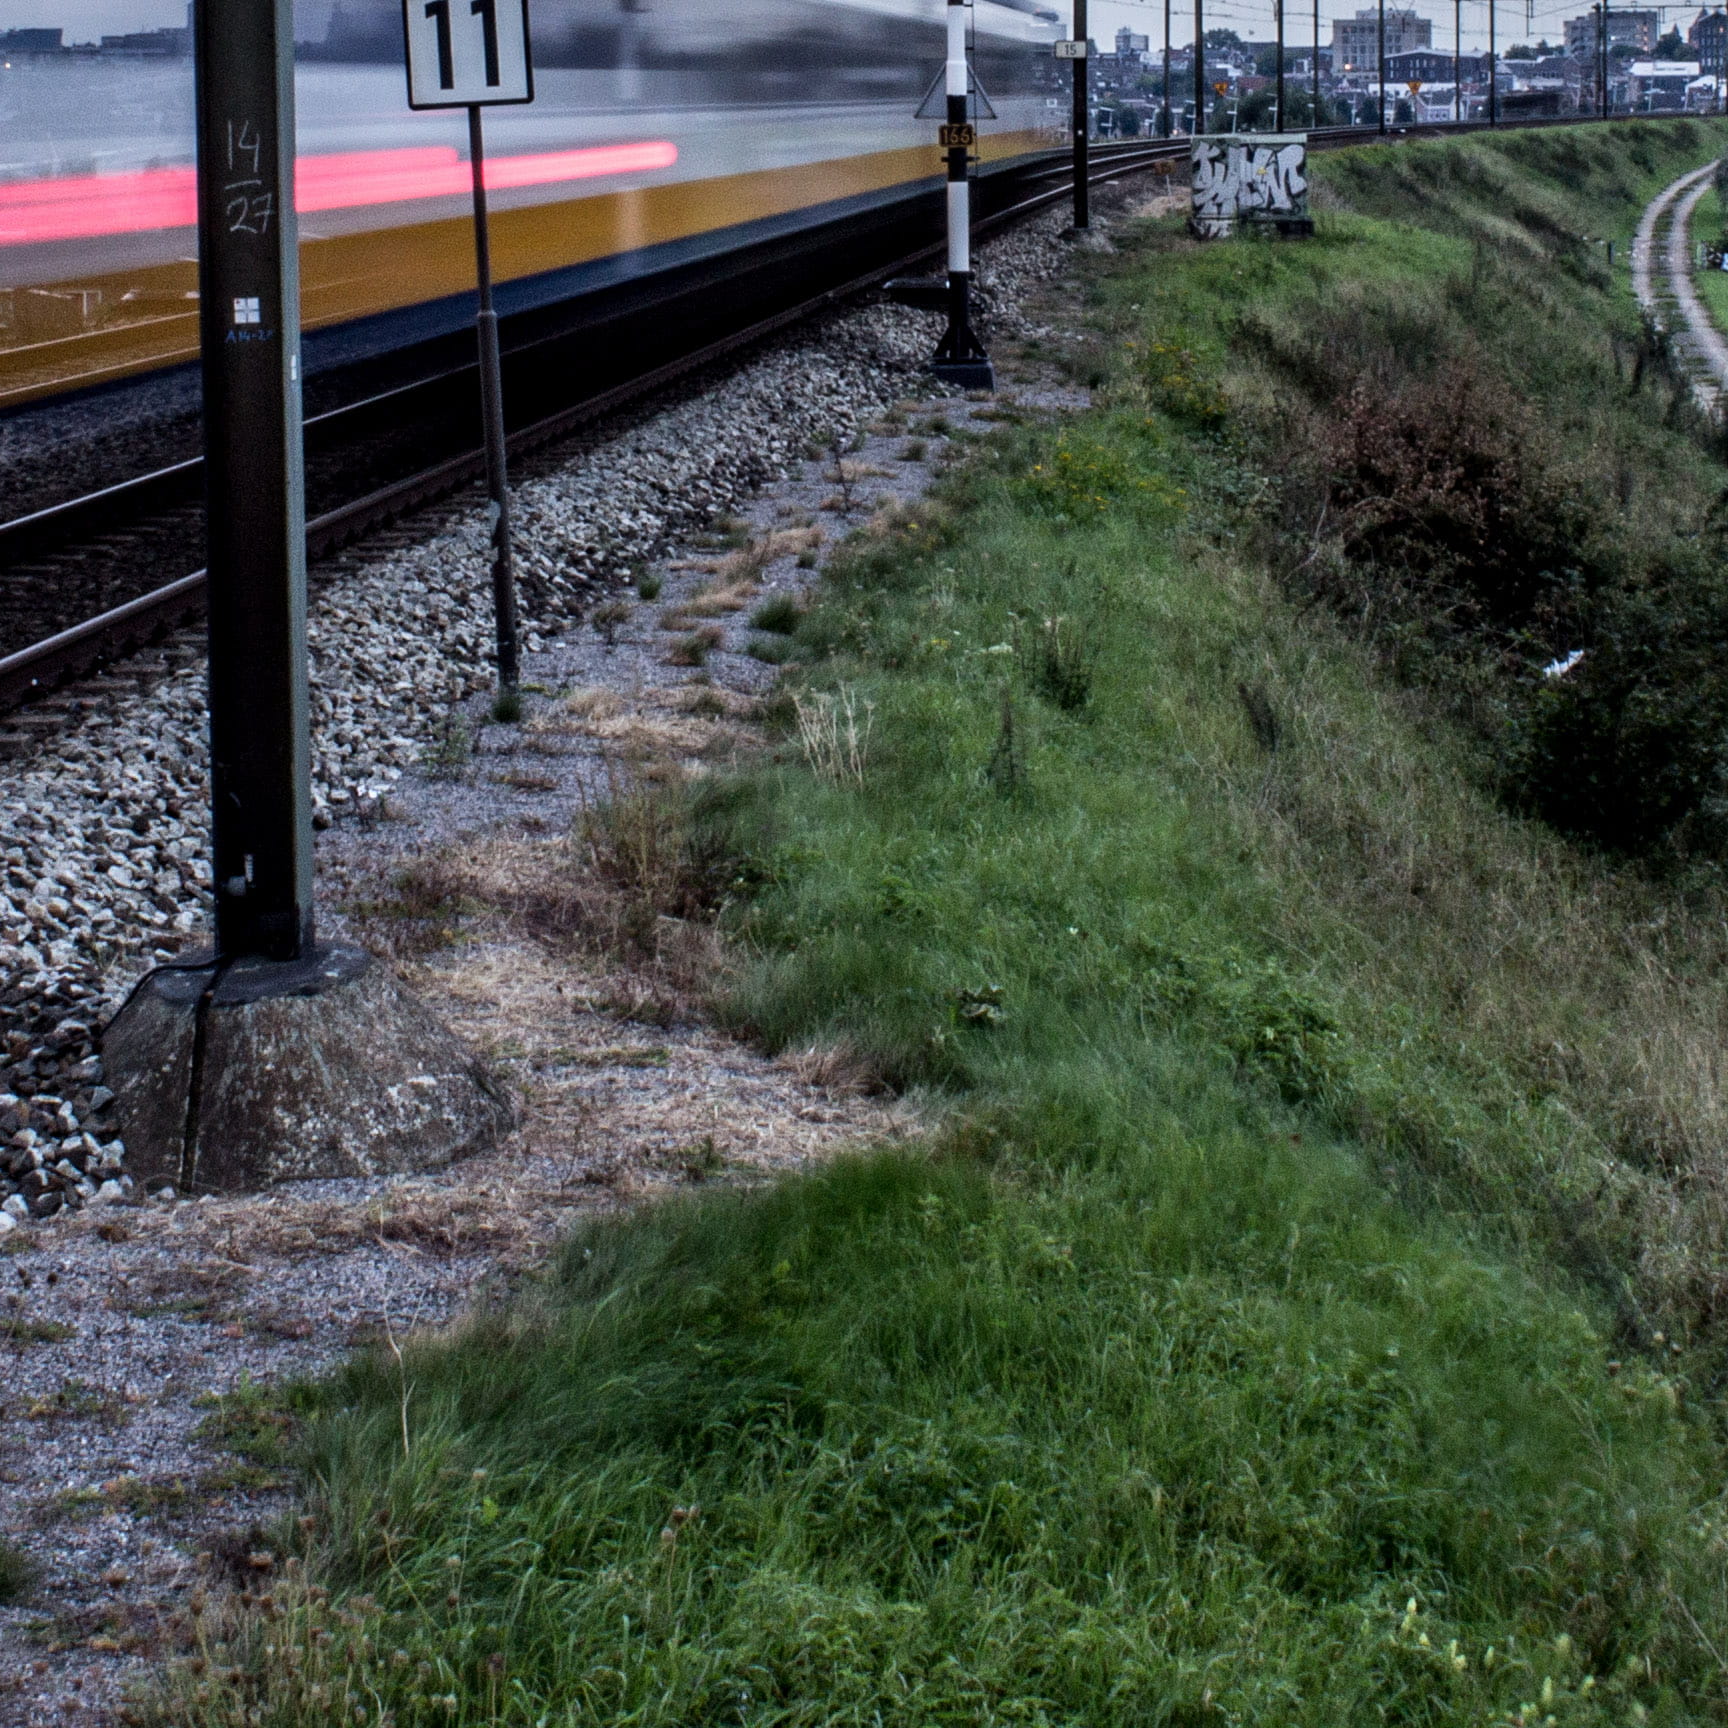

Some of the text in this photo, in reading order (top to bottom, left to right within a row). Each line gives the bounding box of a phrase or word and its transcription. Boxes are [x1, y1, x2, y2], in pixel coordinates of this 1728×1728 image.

[1065, 44, 1077, 56] 15
[226, 119, 260, 172] 14
[943, 127, 970, 144] 166
[226, 193, 272, 234] 27
